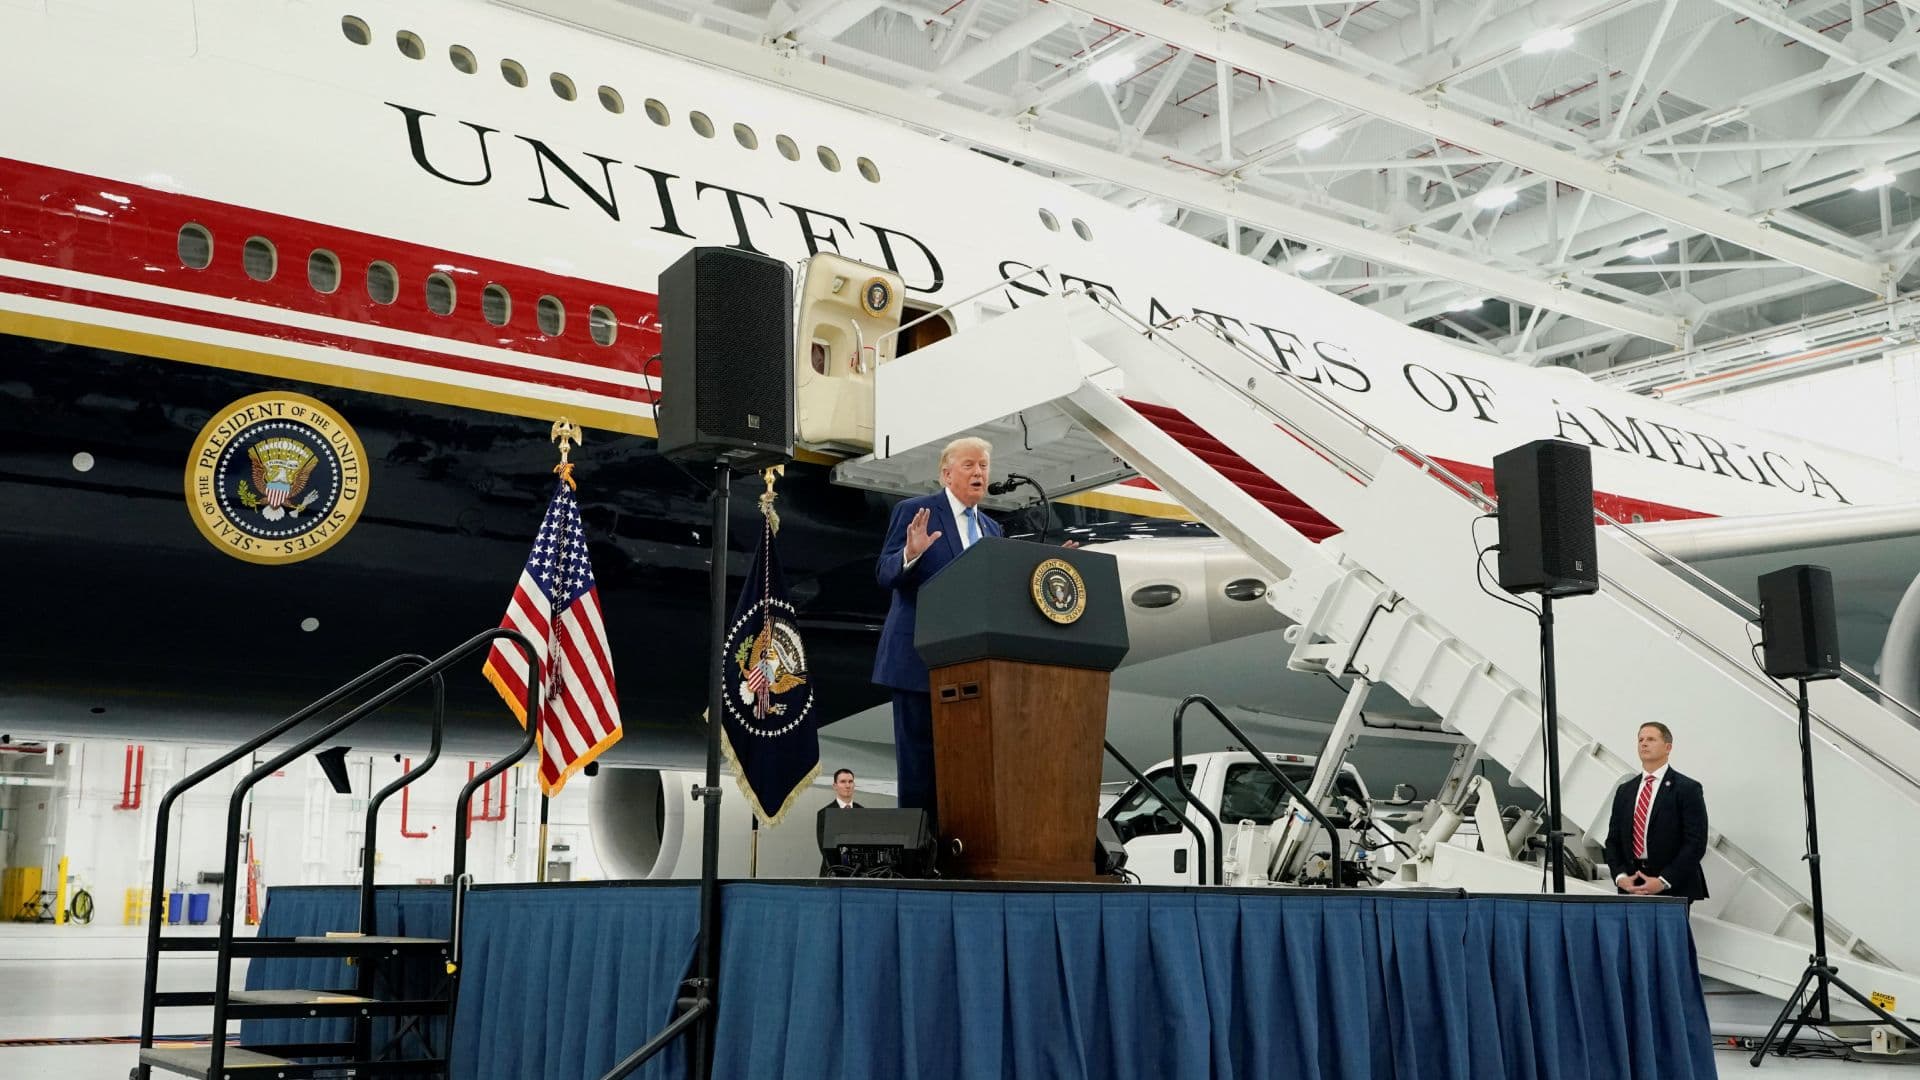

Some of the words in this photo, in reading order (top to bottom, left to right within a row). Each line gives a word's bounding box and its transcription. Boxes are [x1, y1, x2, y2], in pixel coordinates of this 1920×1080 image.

[384, 101, 945, 294] UNITED
[1402, 362, 1499, 425] OF
[1551, 397, 1855, 506] AMERICA
[291, 406, 307, 417] OF
[311, 412, 330, 431] THE
[200, 402, 285, 469] PRESIDENT
[331, 430, 358, 501] UNITED
[200, 475, 209, 497] THE
[202, 500, 215, 515] OF
[212, 520, 254, 550] SEAL
[284, 510, 347, 554] STATES
